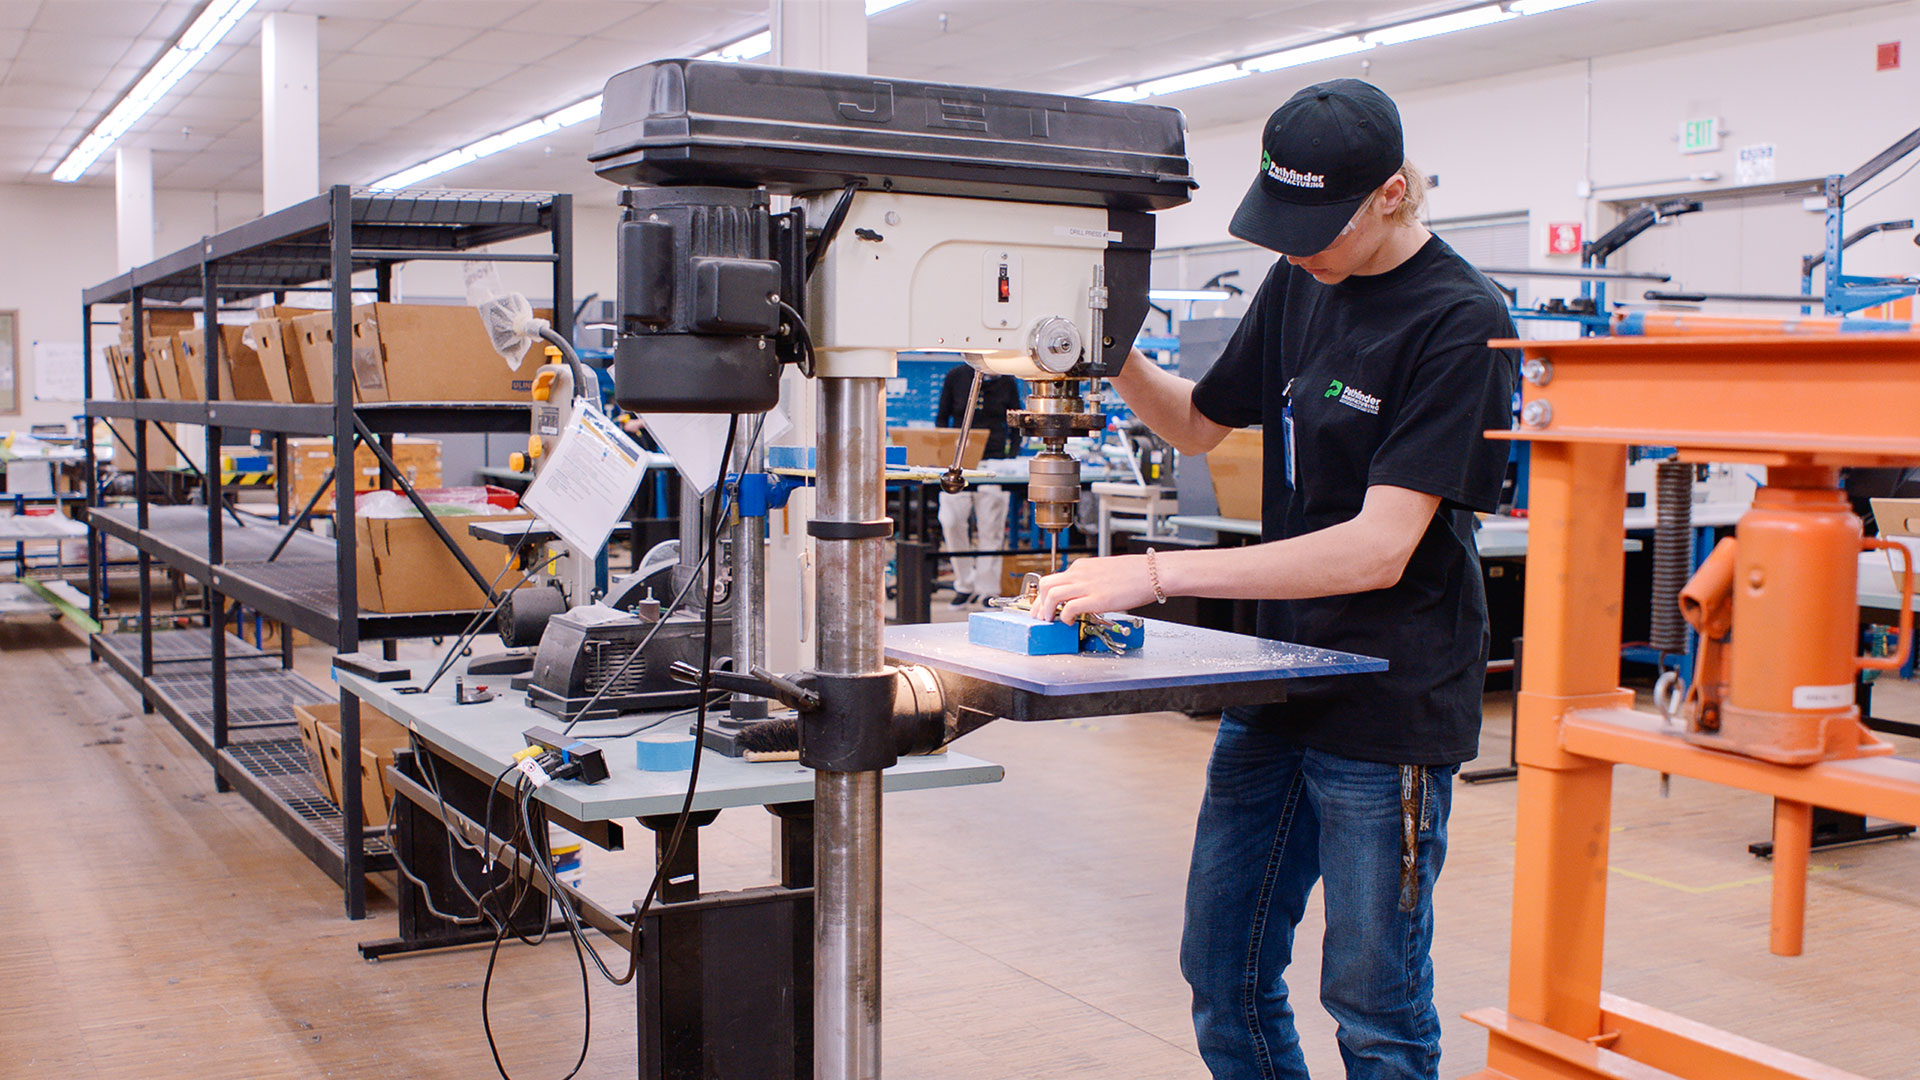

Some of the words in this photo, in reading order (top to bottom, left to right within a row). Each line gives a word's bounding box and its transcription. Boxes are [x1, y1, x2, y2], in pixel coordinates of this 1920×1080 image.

[838, 81, 1067, 138] JET
[1686, 119, 1713, 148] EXIT
[1269, 160, 1325, 183] Pathfinder
[1342, 385, 1382, 406] Pathfinder
